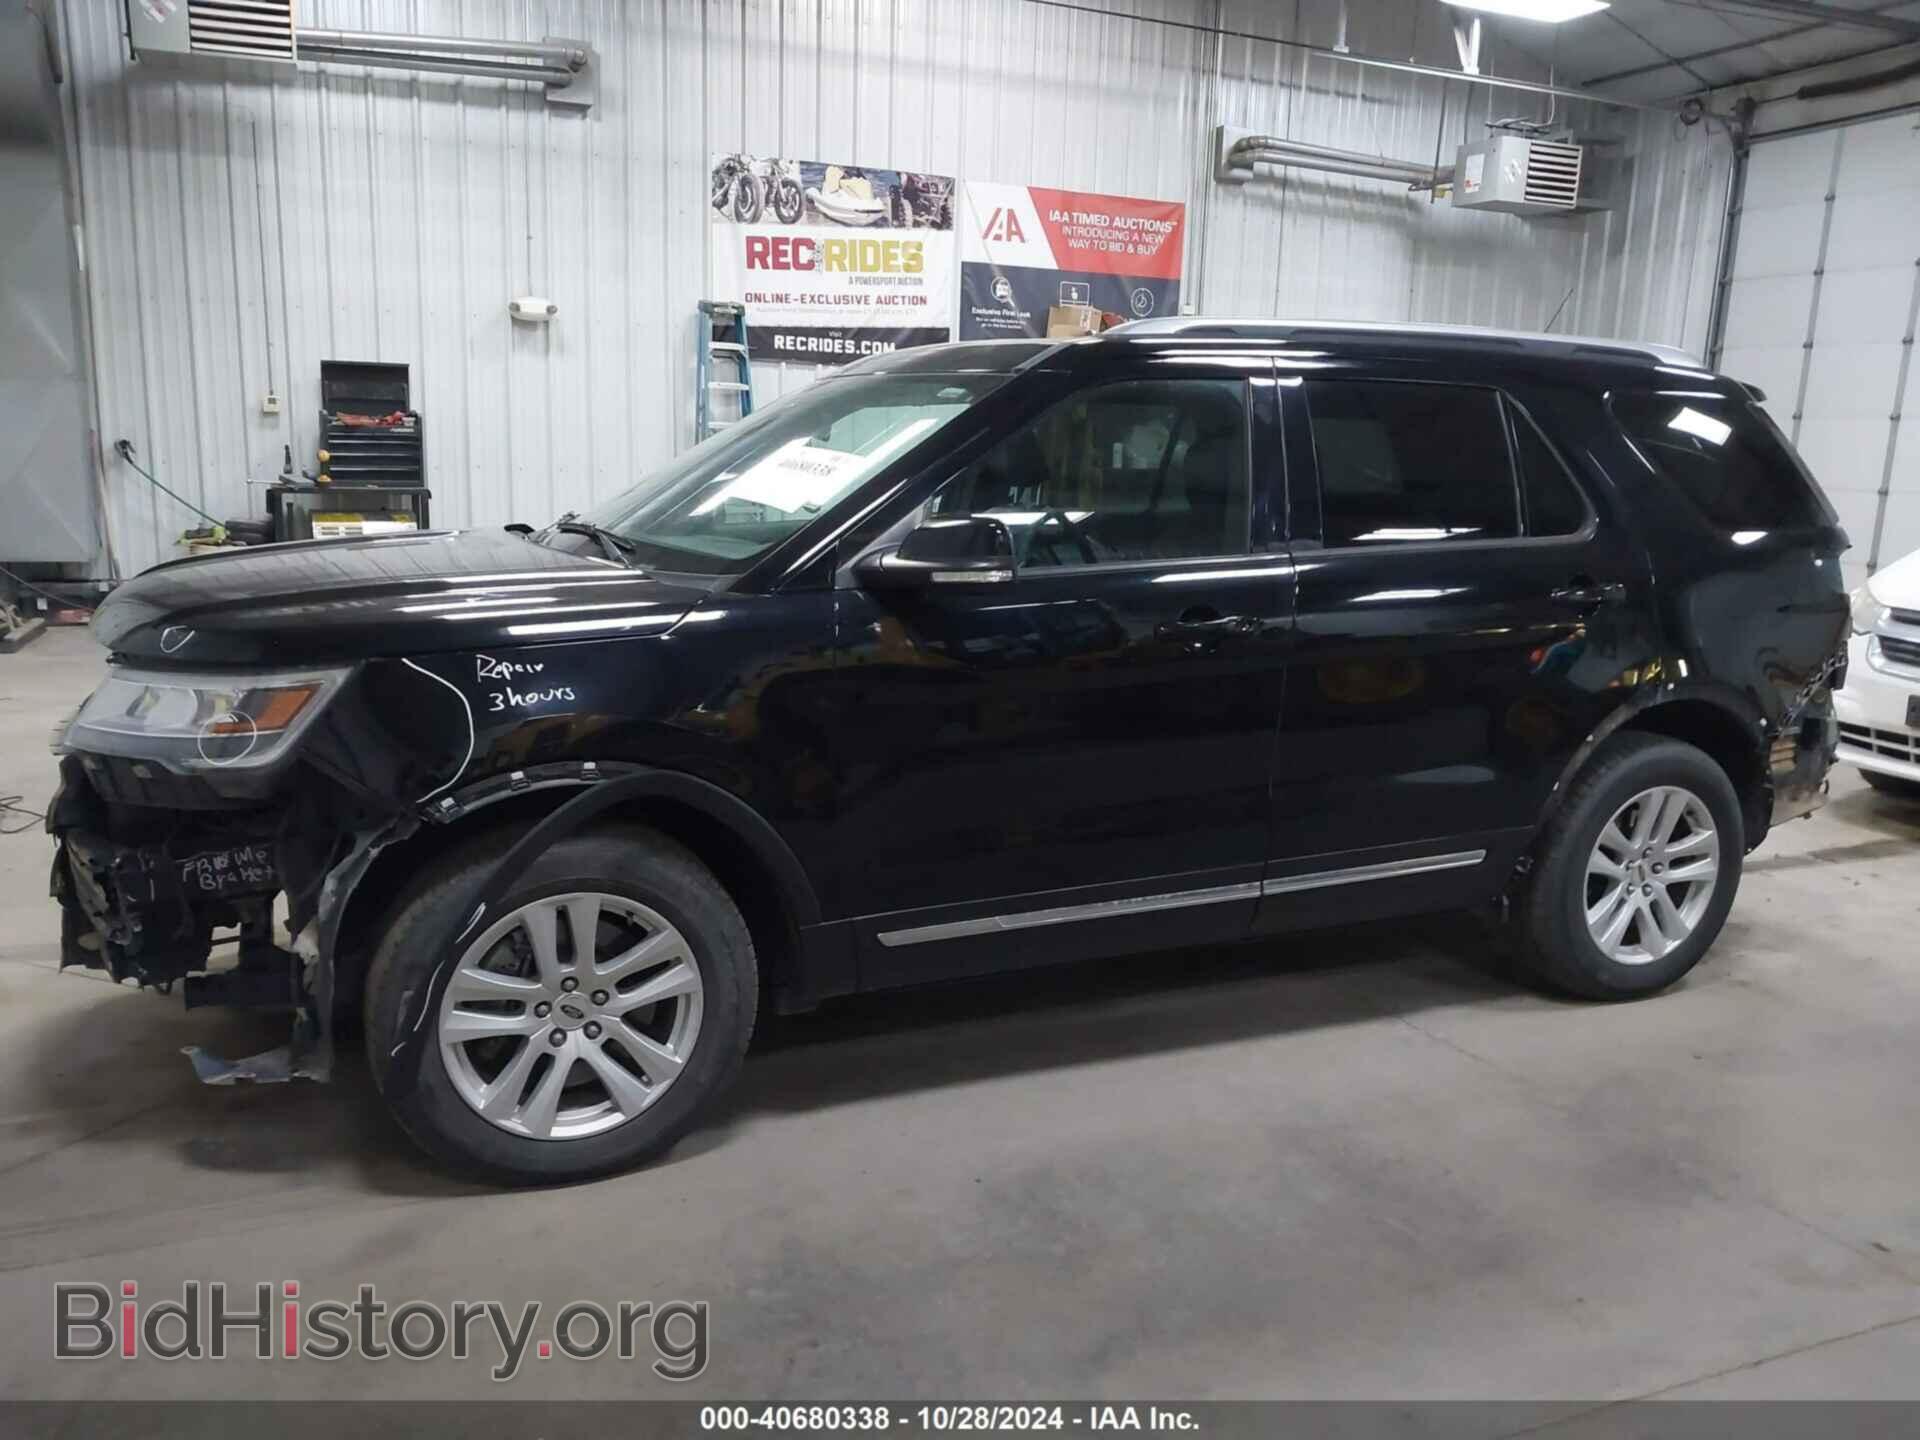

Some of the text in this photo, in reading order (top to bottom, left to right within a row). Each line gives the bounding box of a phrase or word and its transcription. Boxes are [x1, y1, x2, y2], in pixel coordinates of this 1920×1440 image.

[1049, 209, 1070, 224] IAA
[1071, 212, 1110, 227] TIMED
[1062, 226, 1166, 244] INTRODUCING A NEW
[745, 235, 817, 271] REC
[823, 239, 924, 273] RIDES
[1069, 238, 1159, 256] WAY TO BID & BUY
[744, 292, 928, 306] ONLINE-EXCLUSIVE AUCTION
[773, 334, 897, 355] RECRIDES.COM
[475, 654, 545, 683] Repair
